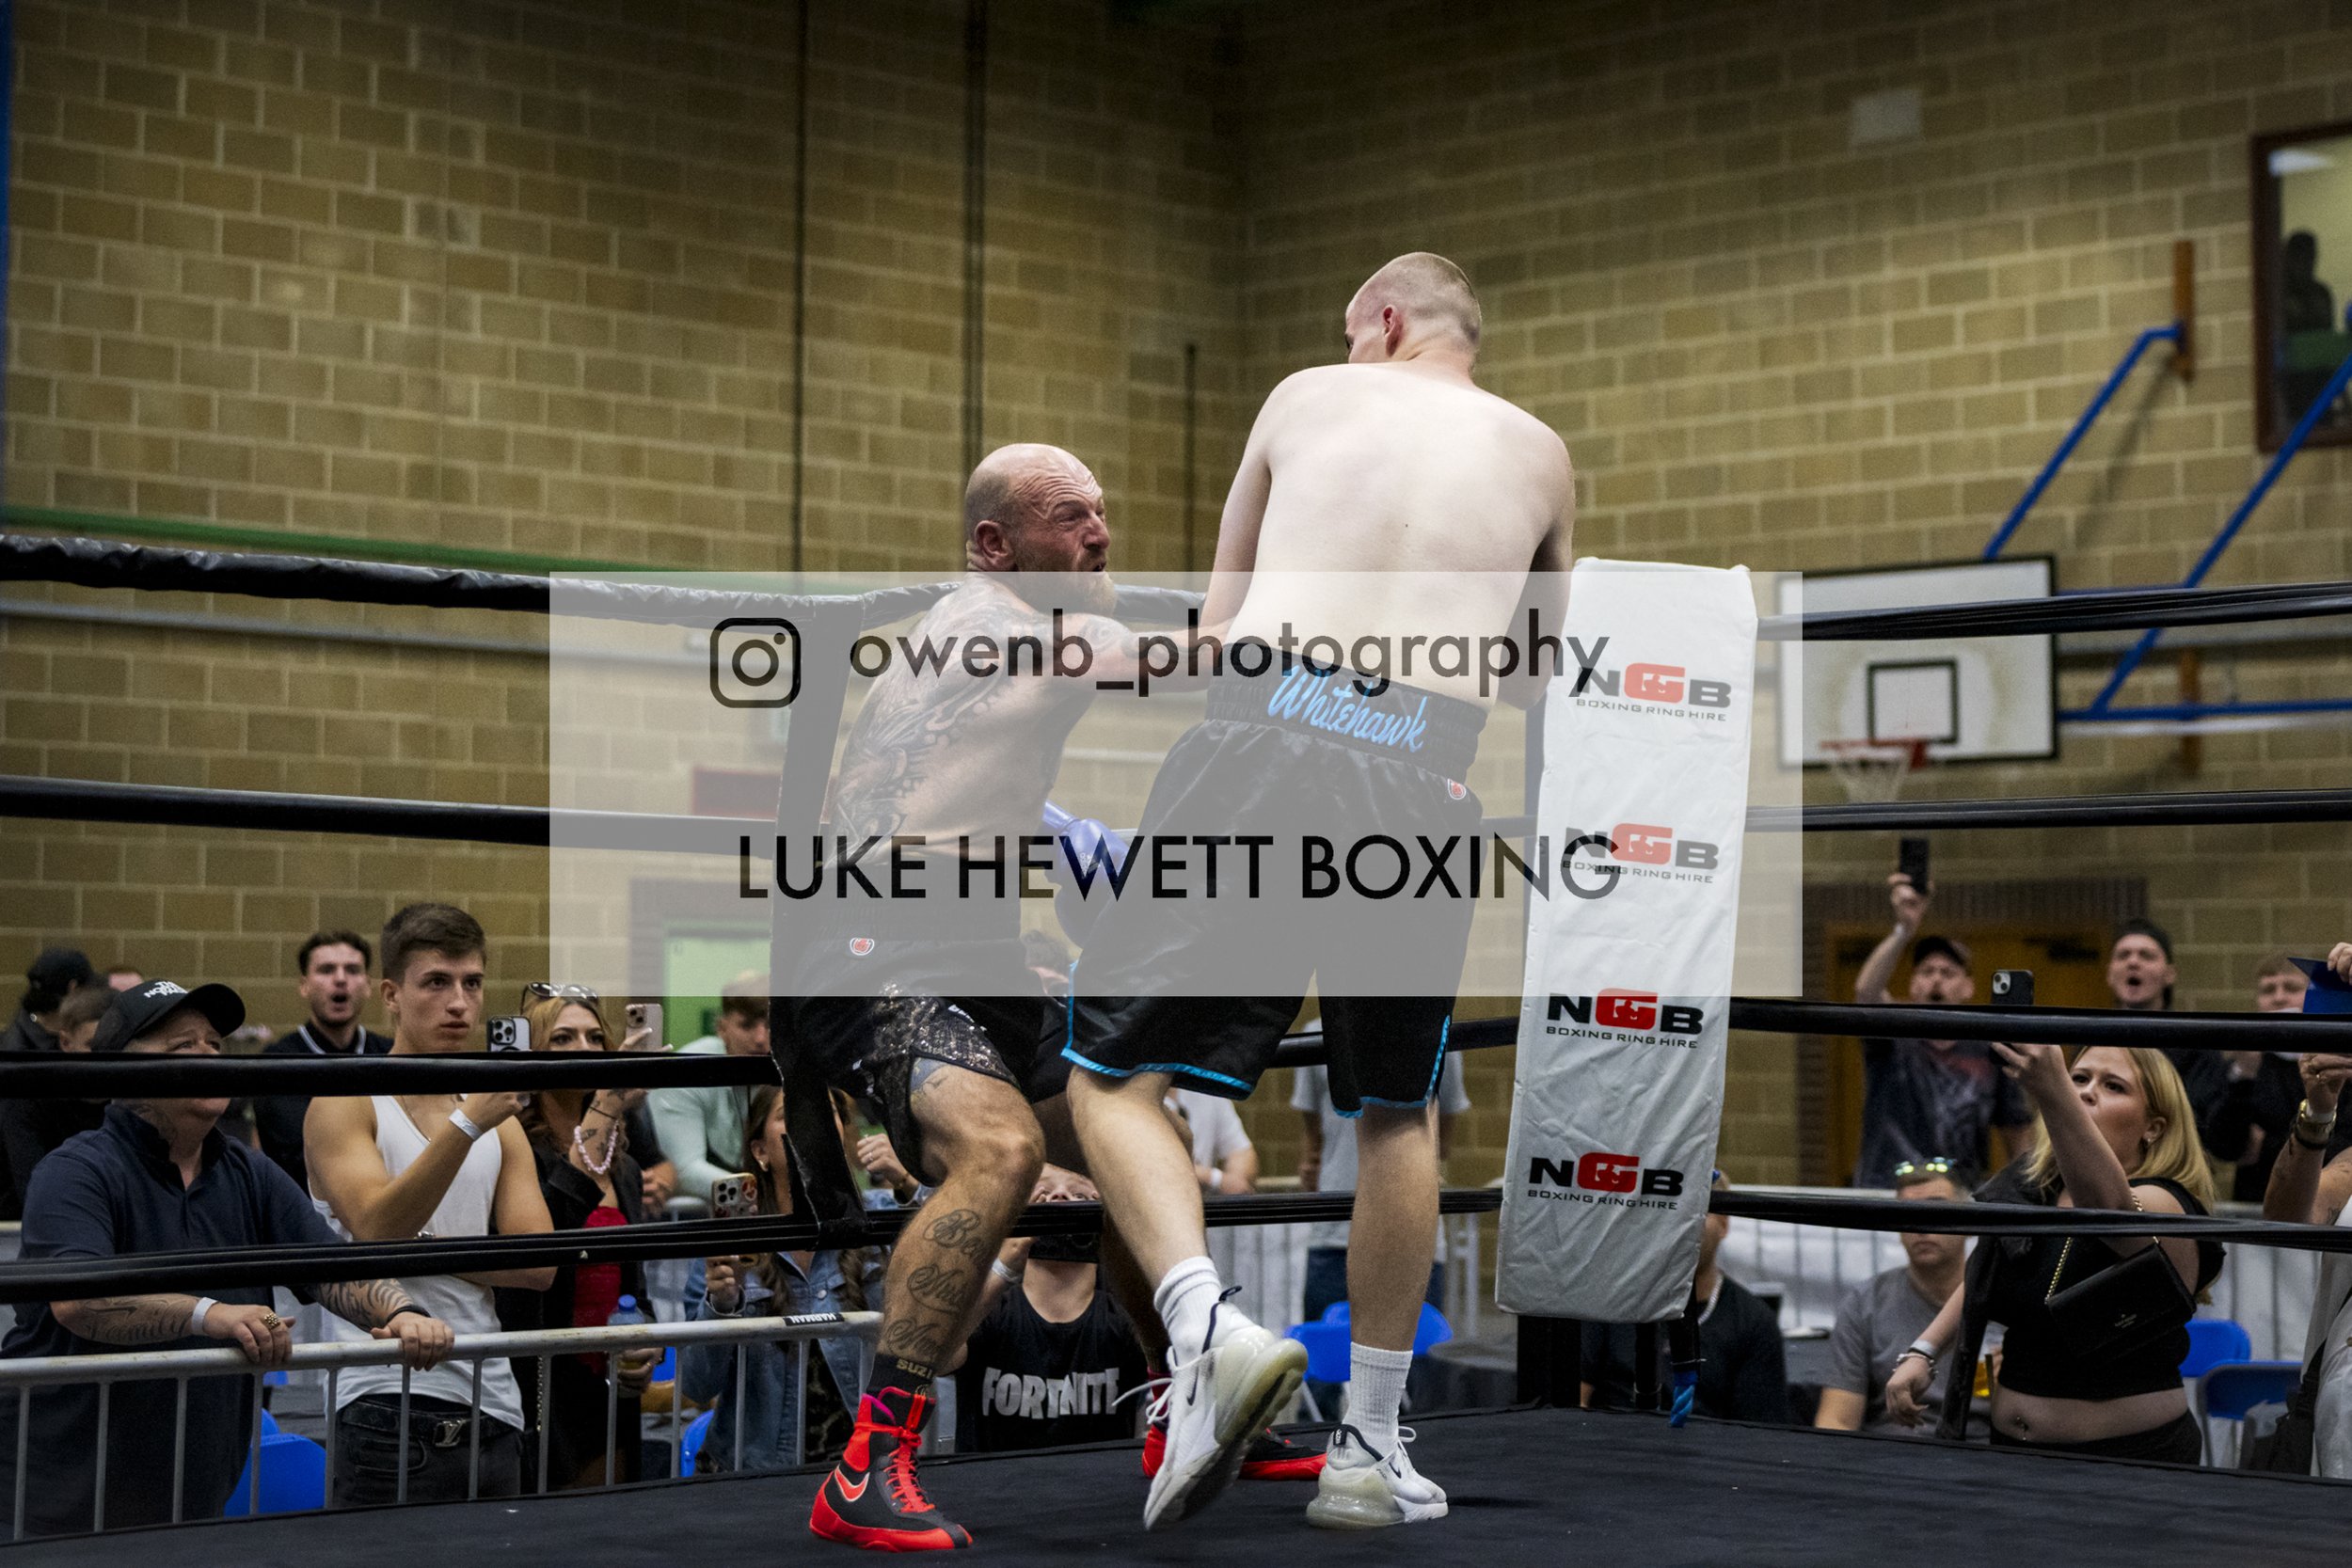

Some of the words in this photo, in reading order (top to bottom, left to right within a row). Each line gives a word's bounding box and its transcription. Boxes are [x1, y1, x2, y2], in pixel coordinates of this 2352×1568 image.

[1577, 662, 1731, 708] NGB
[1267, 665, 1427, 752] Whitehawk
[1576, 699, 1642, 713] BOXING
[1646, 707, 1684, 718] RING
[1689, 711, 1726, 721] HIRE
[1565, 822, 1719, 870] NGB
[1563, 860, 1629, 875] BOXING
[1632, 868, 1671, 879] RING
[1676, 873, 1714, 883] HIRE
[1547, 988, 1704, 1035] NGB
[1546, 1025, 1613, 1040] BOXING
[1616, 1034, 1656, 1045] RING
[1660, 1037, 1698, 1049] HIRE
[1529, 1152, 1684, 1196] NGB
[1528, 1190, 1594, 1203] BOXING
[1597, 1197, 1636, 1208] RING
[1640, 1200, 1677, 1211] HIRE
[982, 1367, 1120, 1419] FORTNITE
